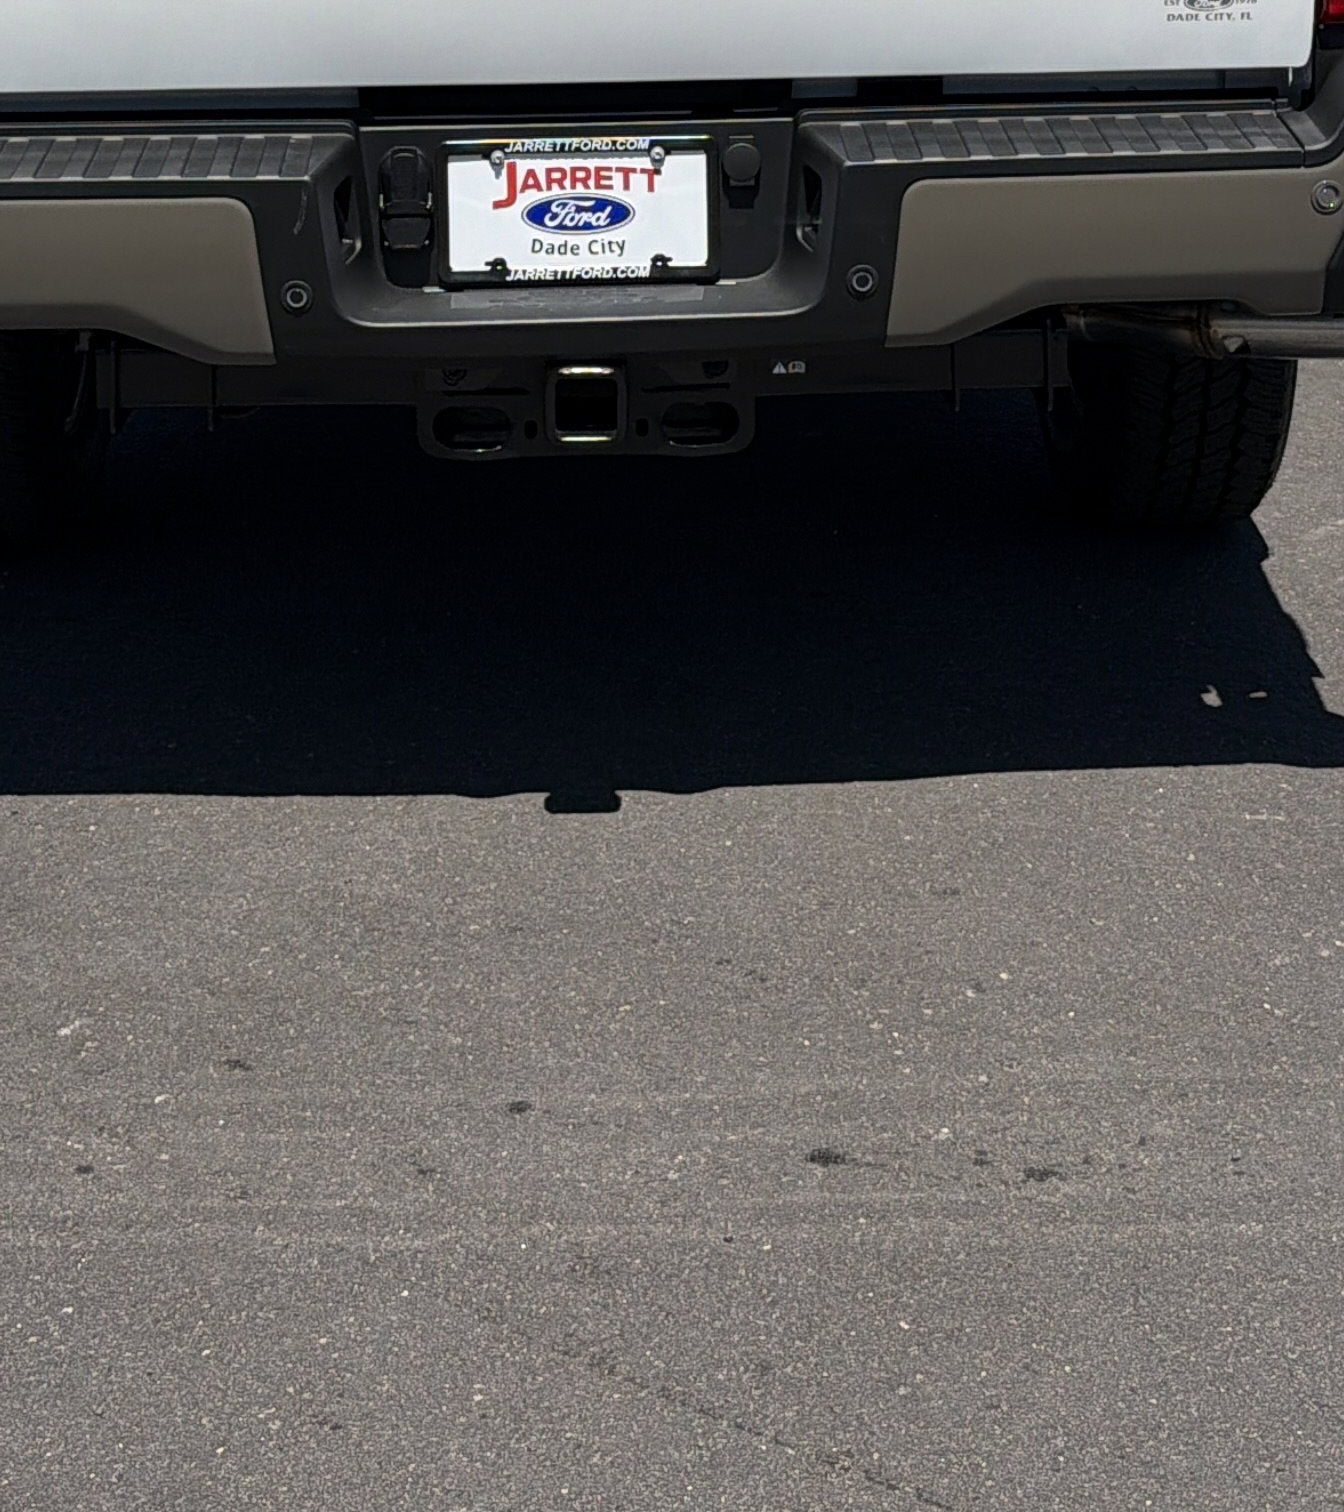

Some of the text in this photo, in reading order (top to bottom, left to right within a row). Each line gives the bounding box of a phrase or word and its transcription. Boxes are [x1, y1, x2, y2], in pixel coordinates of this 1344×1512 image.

[1166, 13, 1201, 22] DADE
[1240, 11, 1253, 21] FL
[504, 138, 650, 154] JARRETTFORD.COM
[492, 161, 662, 210] JARRETT
[543, 199, 611, 228] Ford
[531, 237, 627, 257] Dade City
[505, 265, 651, 282] JARRETTFORD.COM
